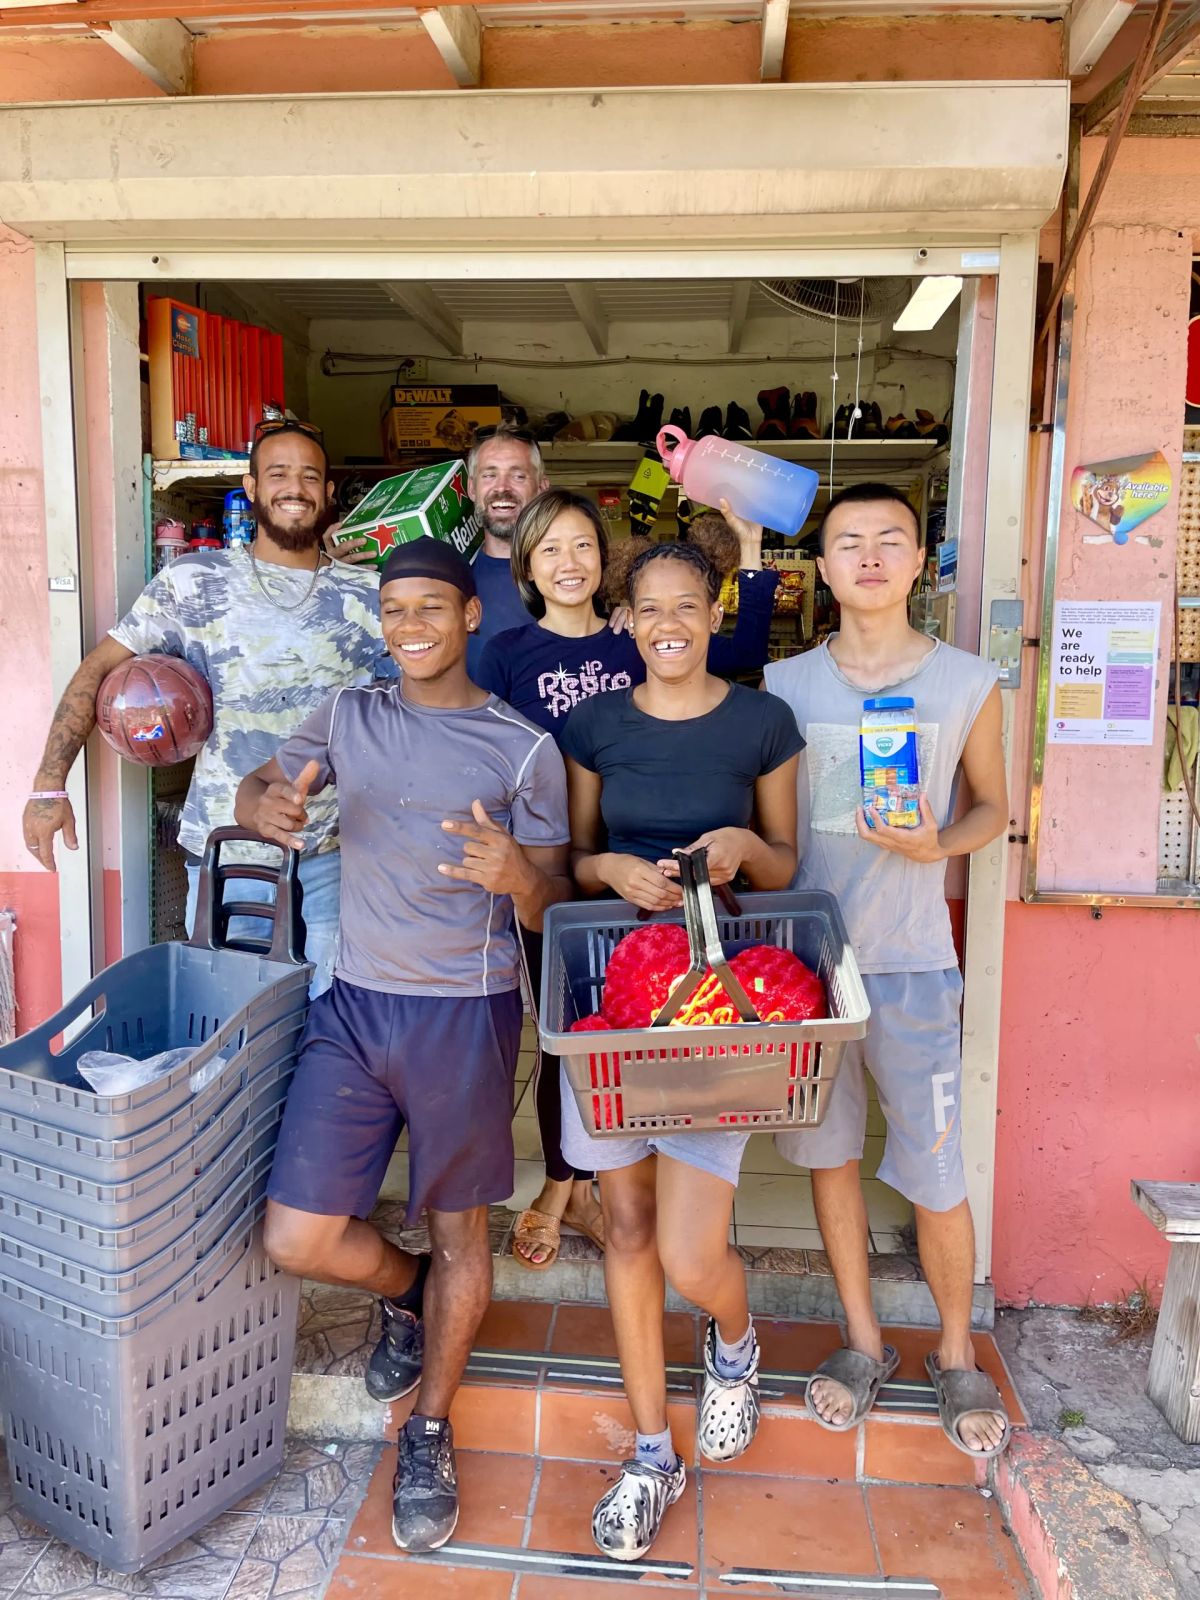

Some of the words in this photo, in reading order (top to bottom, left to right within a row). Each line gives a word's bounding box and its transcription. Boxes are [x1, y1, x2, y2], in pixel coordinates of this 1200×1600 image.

[176, 332, 193, 344] Hose
[1124, 482, 1169, 494] Available
[1062, 628, 1083, 638] We
[1061, 642, 1080, 650] are
[1060, 653, 1095, 664] ready
[1060, 666, 1072, 675] to
[1076, 665, 1102, 677] help
